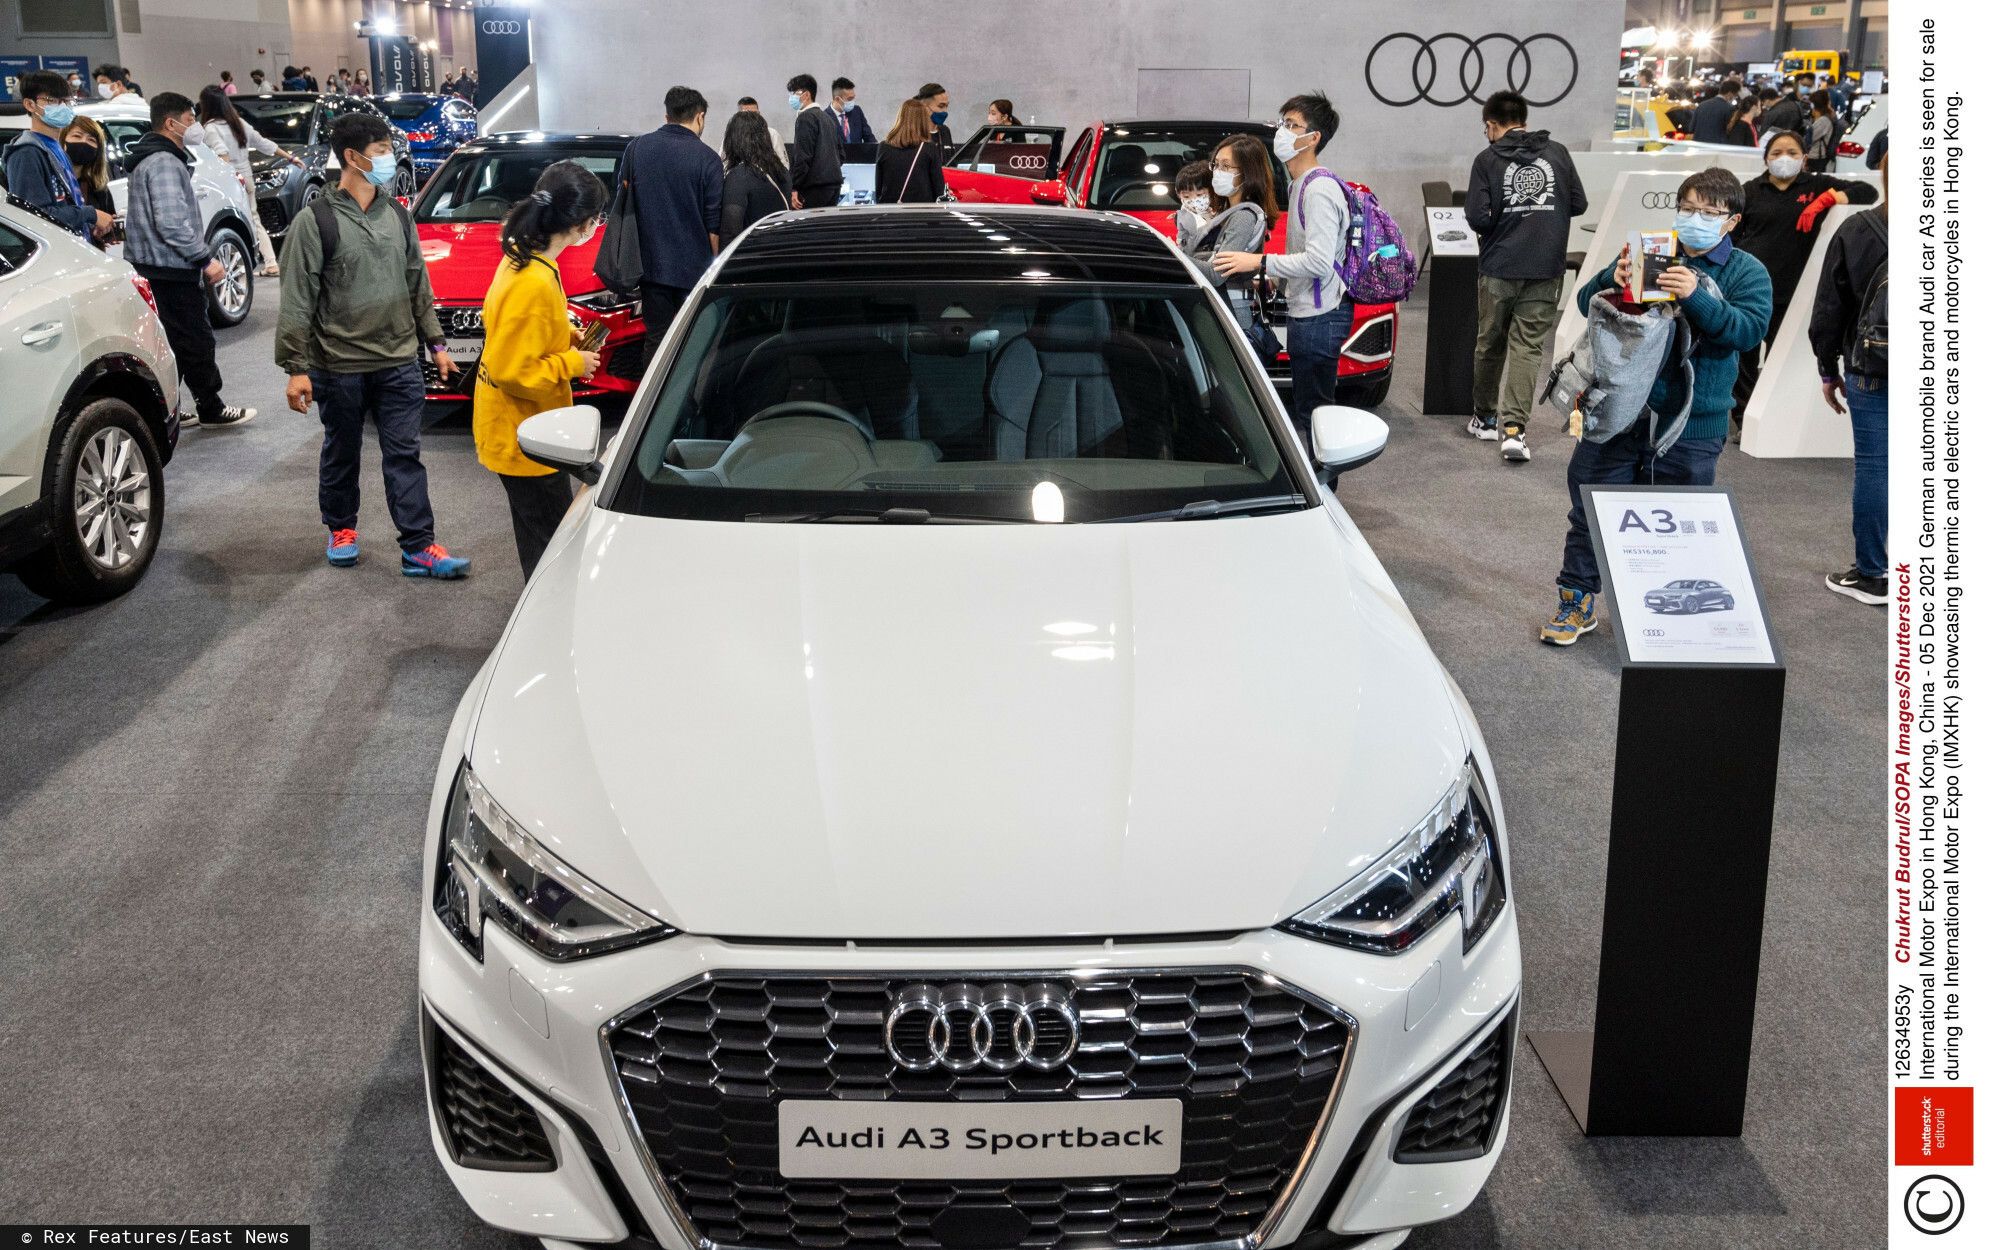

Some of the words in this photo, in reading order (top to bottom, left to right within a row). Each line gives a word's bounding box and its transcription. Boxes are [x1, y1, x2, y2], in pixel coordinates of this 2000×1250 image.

[1433, 211, 1455, 221] Q2
[1619, 509, 1678, 534] A3
[795, 1126, 884, 1149] Audi
[897, 1127, 950, 1150] A3
[965, 1124, 1163, 1155] Sportback
